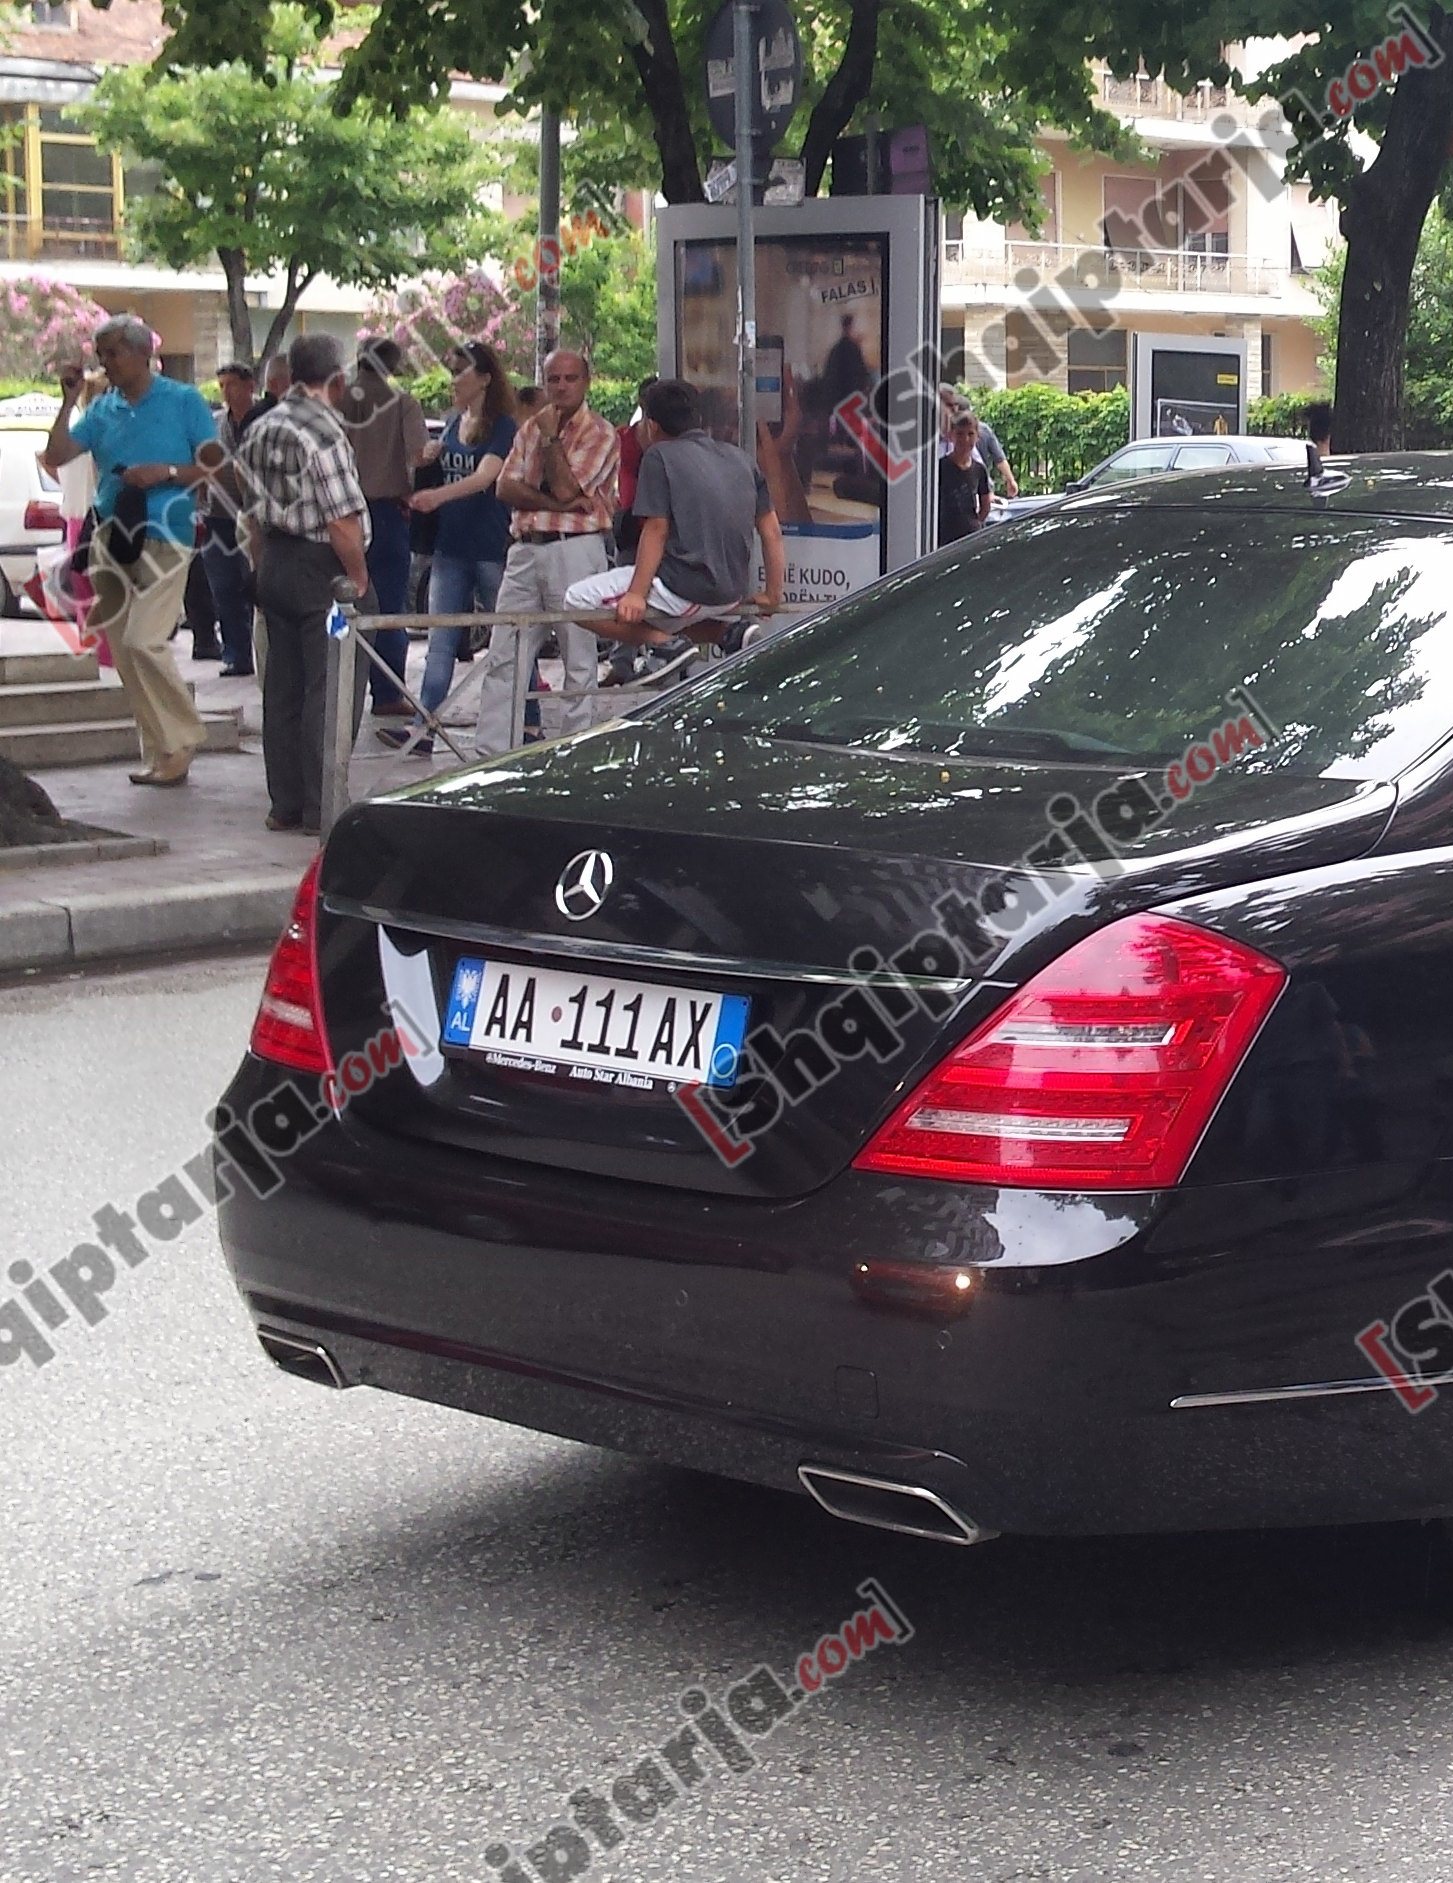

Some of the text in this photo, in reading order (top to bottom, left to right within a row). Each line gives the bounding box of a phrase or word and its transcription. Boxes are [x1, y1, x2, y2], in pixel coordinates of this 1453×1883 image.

[800, 568, 850, 591] KUDO,
[484, 973, 537, 1044] AA
[450, 1010, 471, 1033] AL
[569, 1065, 593, 1081] Auto
[614, 1071, 654, 1090] Albania
